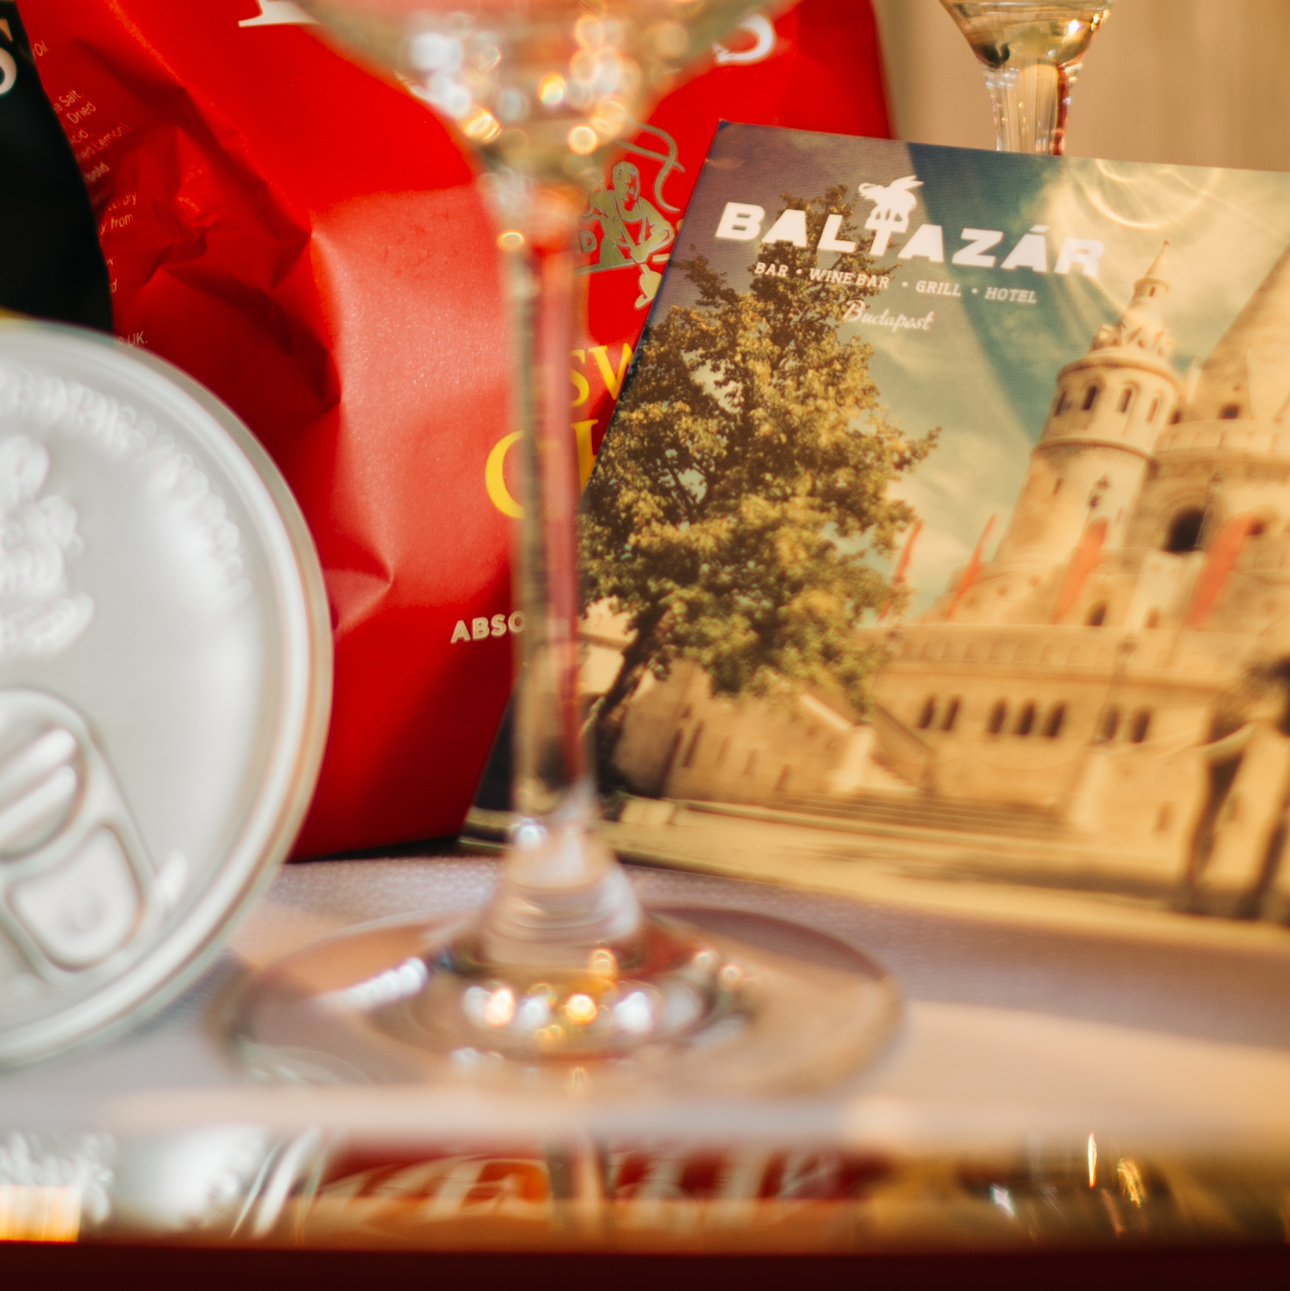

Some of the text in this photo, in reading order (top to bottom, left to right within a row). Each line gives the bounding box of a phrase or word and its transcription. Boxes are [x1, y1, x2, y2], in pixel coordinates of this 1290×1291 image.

[715, 201, 1105, 278] BALTAZÁR
[754, 261, 790, 278] BAR
[914, 279, 963, 298] GRILL
[984, 285, 1038, 305] HOTEL
[841, 298, 936, 333] Budapest
